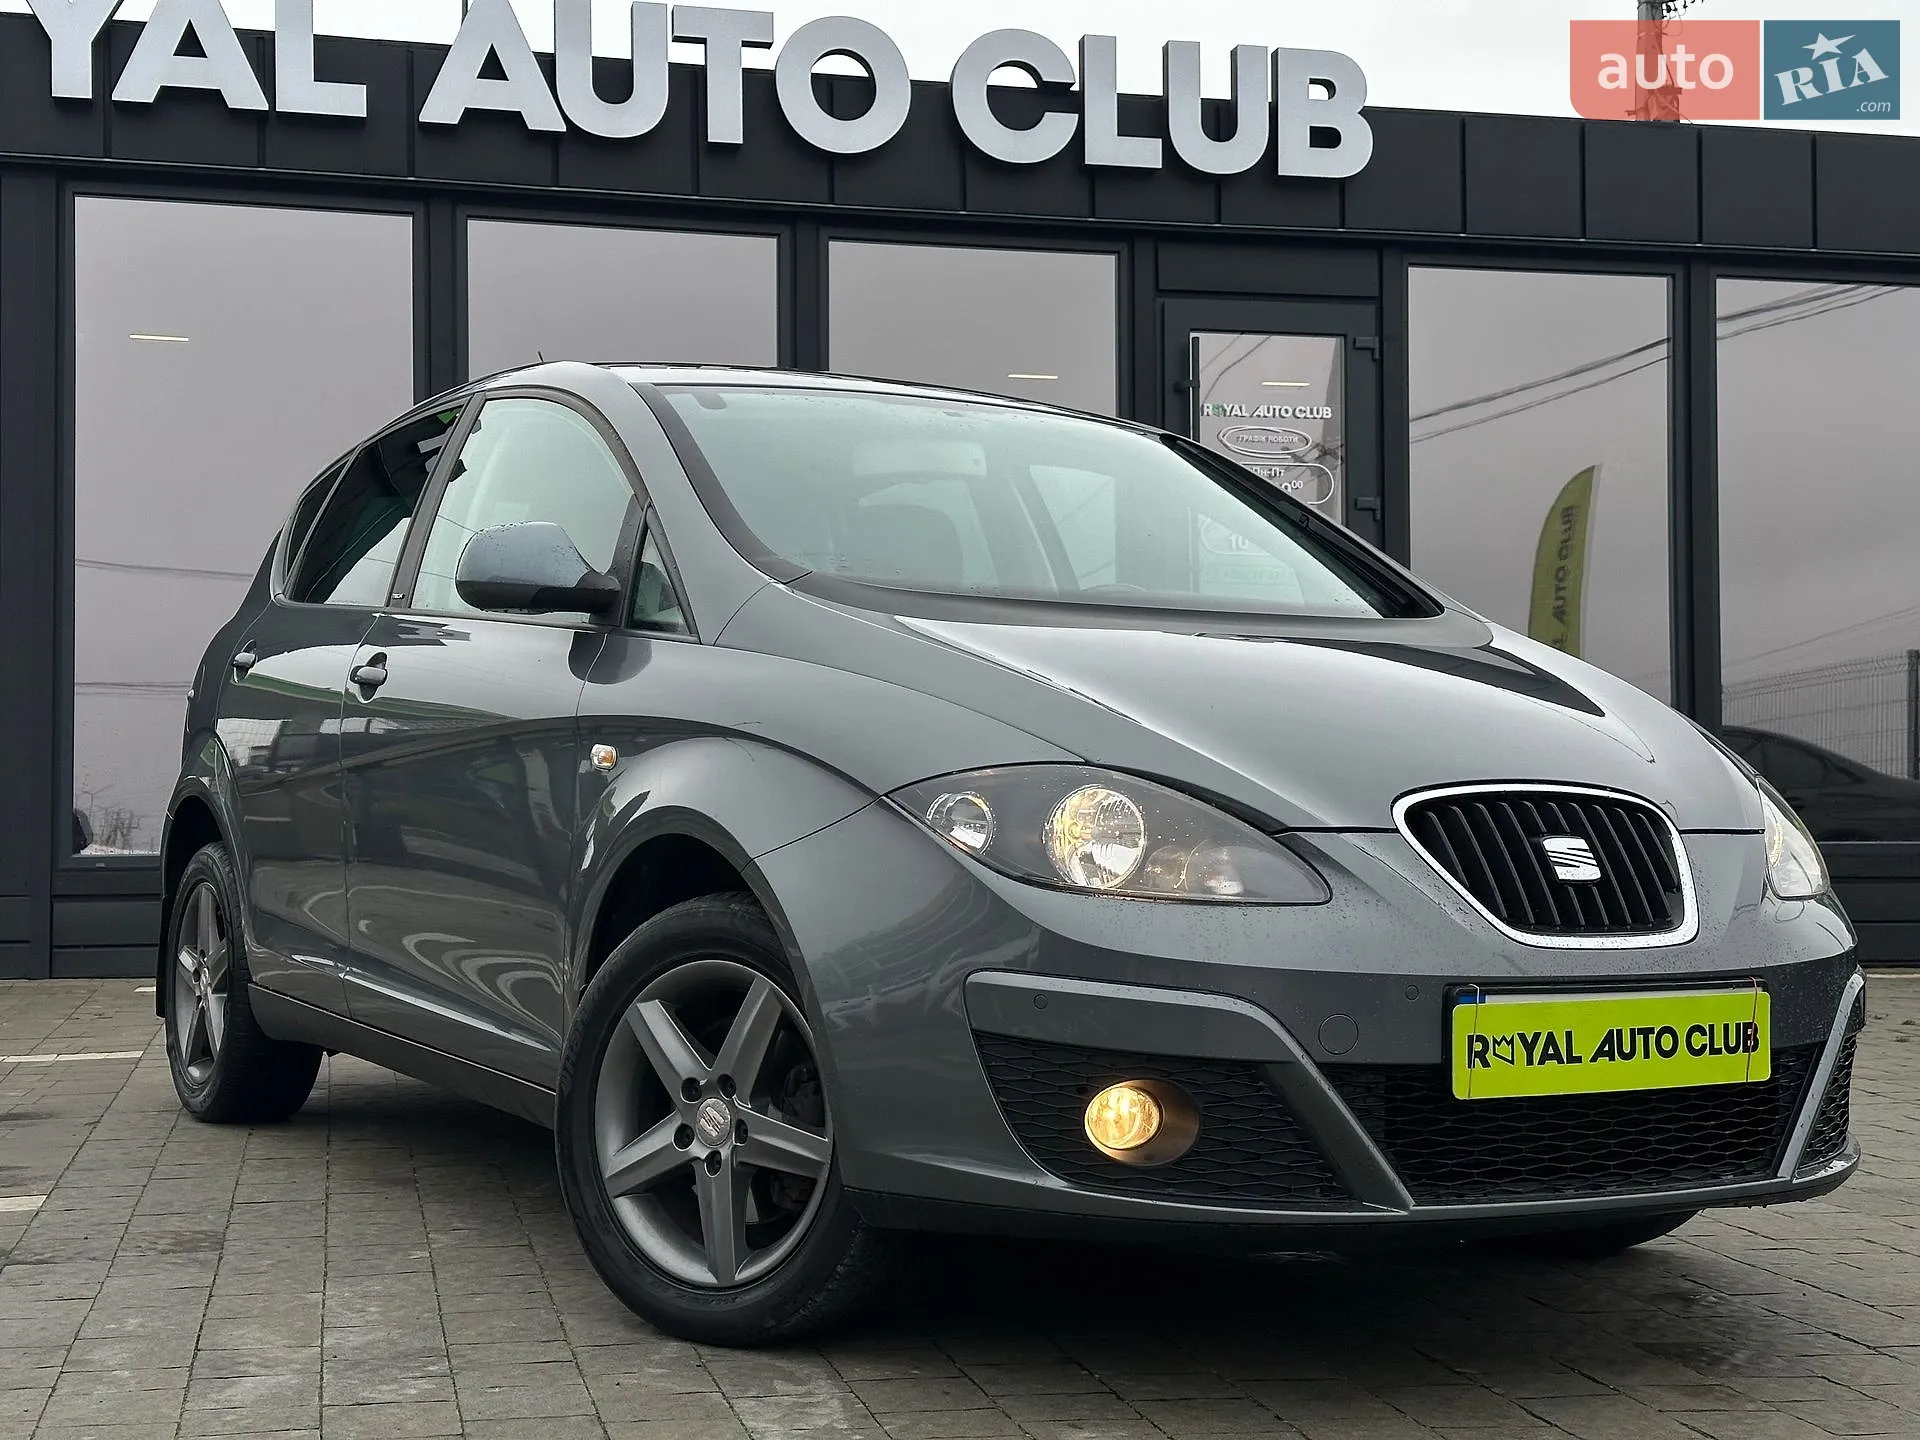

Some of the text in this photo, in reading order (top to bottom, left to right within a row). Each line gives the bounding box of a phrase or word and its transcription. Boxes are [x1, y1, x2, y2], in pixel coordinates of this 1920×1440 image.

[418, 0, 912, 154] AUTO
[951, 28, 1374, 180] CLUB
[1251, 405, 1292, 419] AUTO
[1295, 406, 1333, 419] CLUB
[1552, 565, 1569, 625] AUTO
[1589, 1024, 1680, 1063] AUTO
[1685, 1021, 1760, 1057] CLUB
